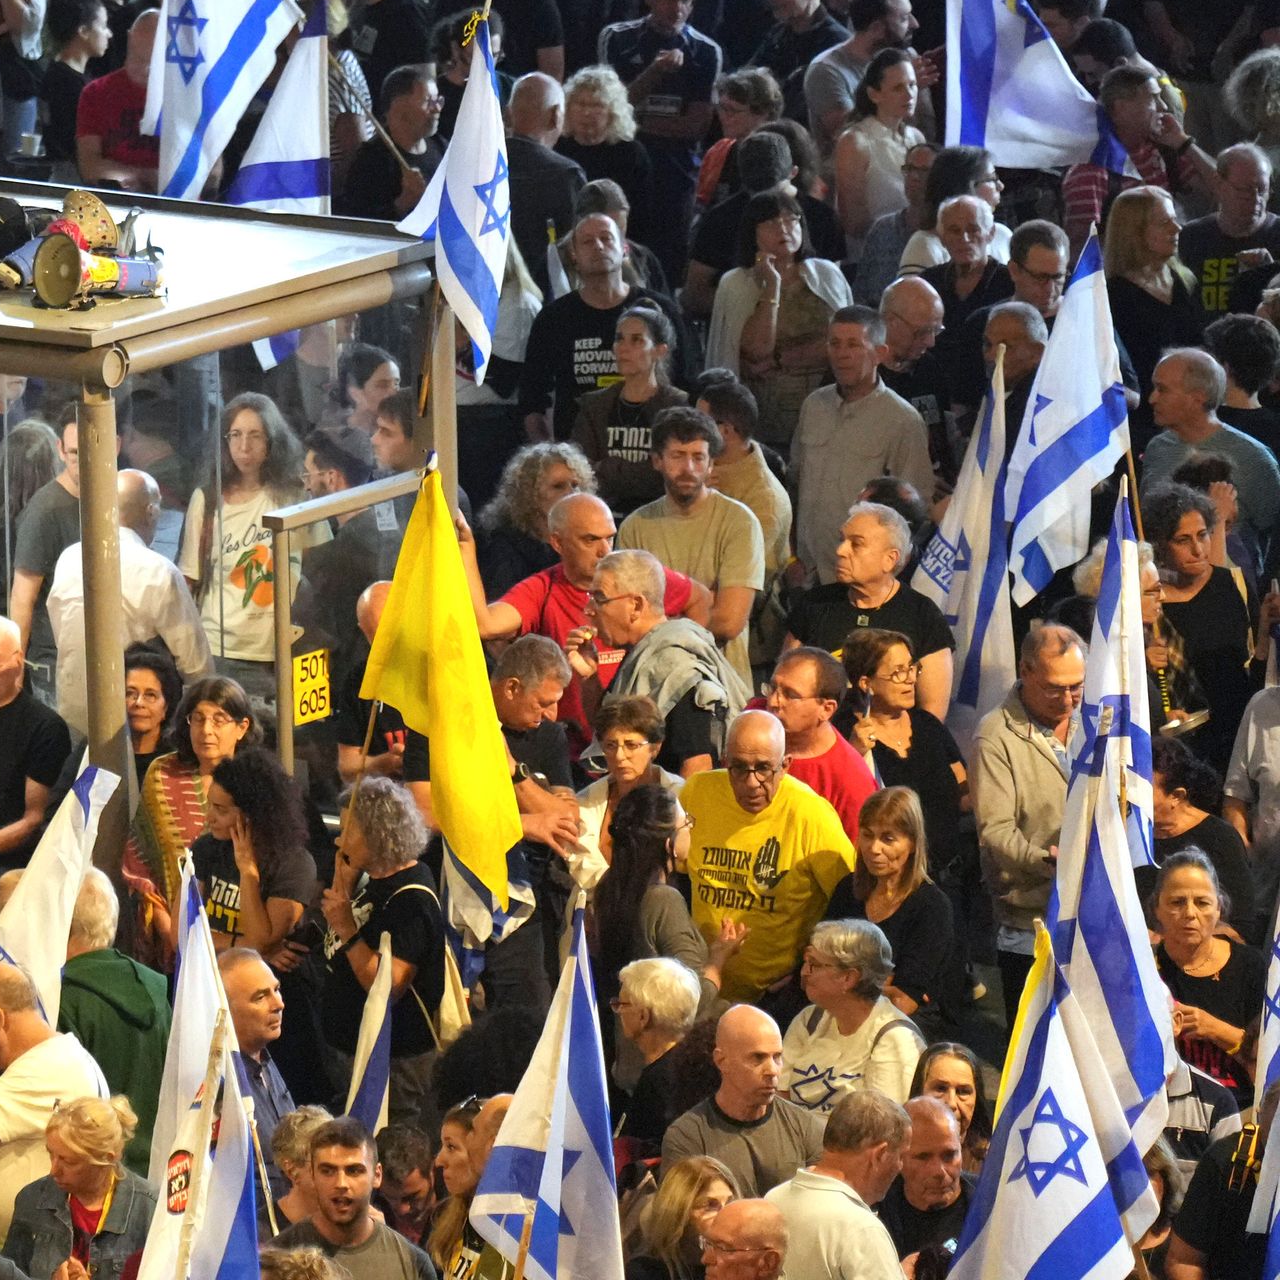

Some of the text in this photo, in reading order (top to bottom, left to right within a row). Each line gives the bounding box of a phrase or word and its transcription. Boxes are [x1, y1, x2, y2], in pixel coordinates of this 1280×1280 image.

[1202, 258, 1238, 284] SE
[575, 337, 602, 349] KEEP
[574, 349, 617, 363] MOVIN
[574, 362, 619, 375] FORWA
[243, 523, 273, 548] Ora
[300, 652, 326, 683] 501
[300, 686, 327, 716] 605
[702, 847, 752, 870] אוקטובר
[760, 895, 775, 913] די
[171, 1174, 186, 1194] לא
